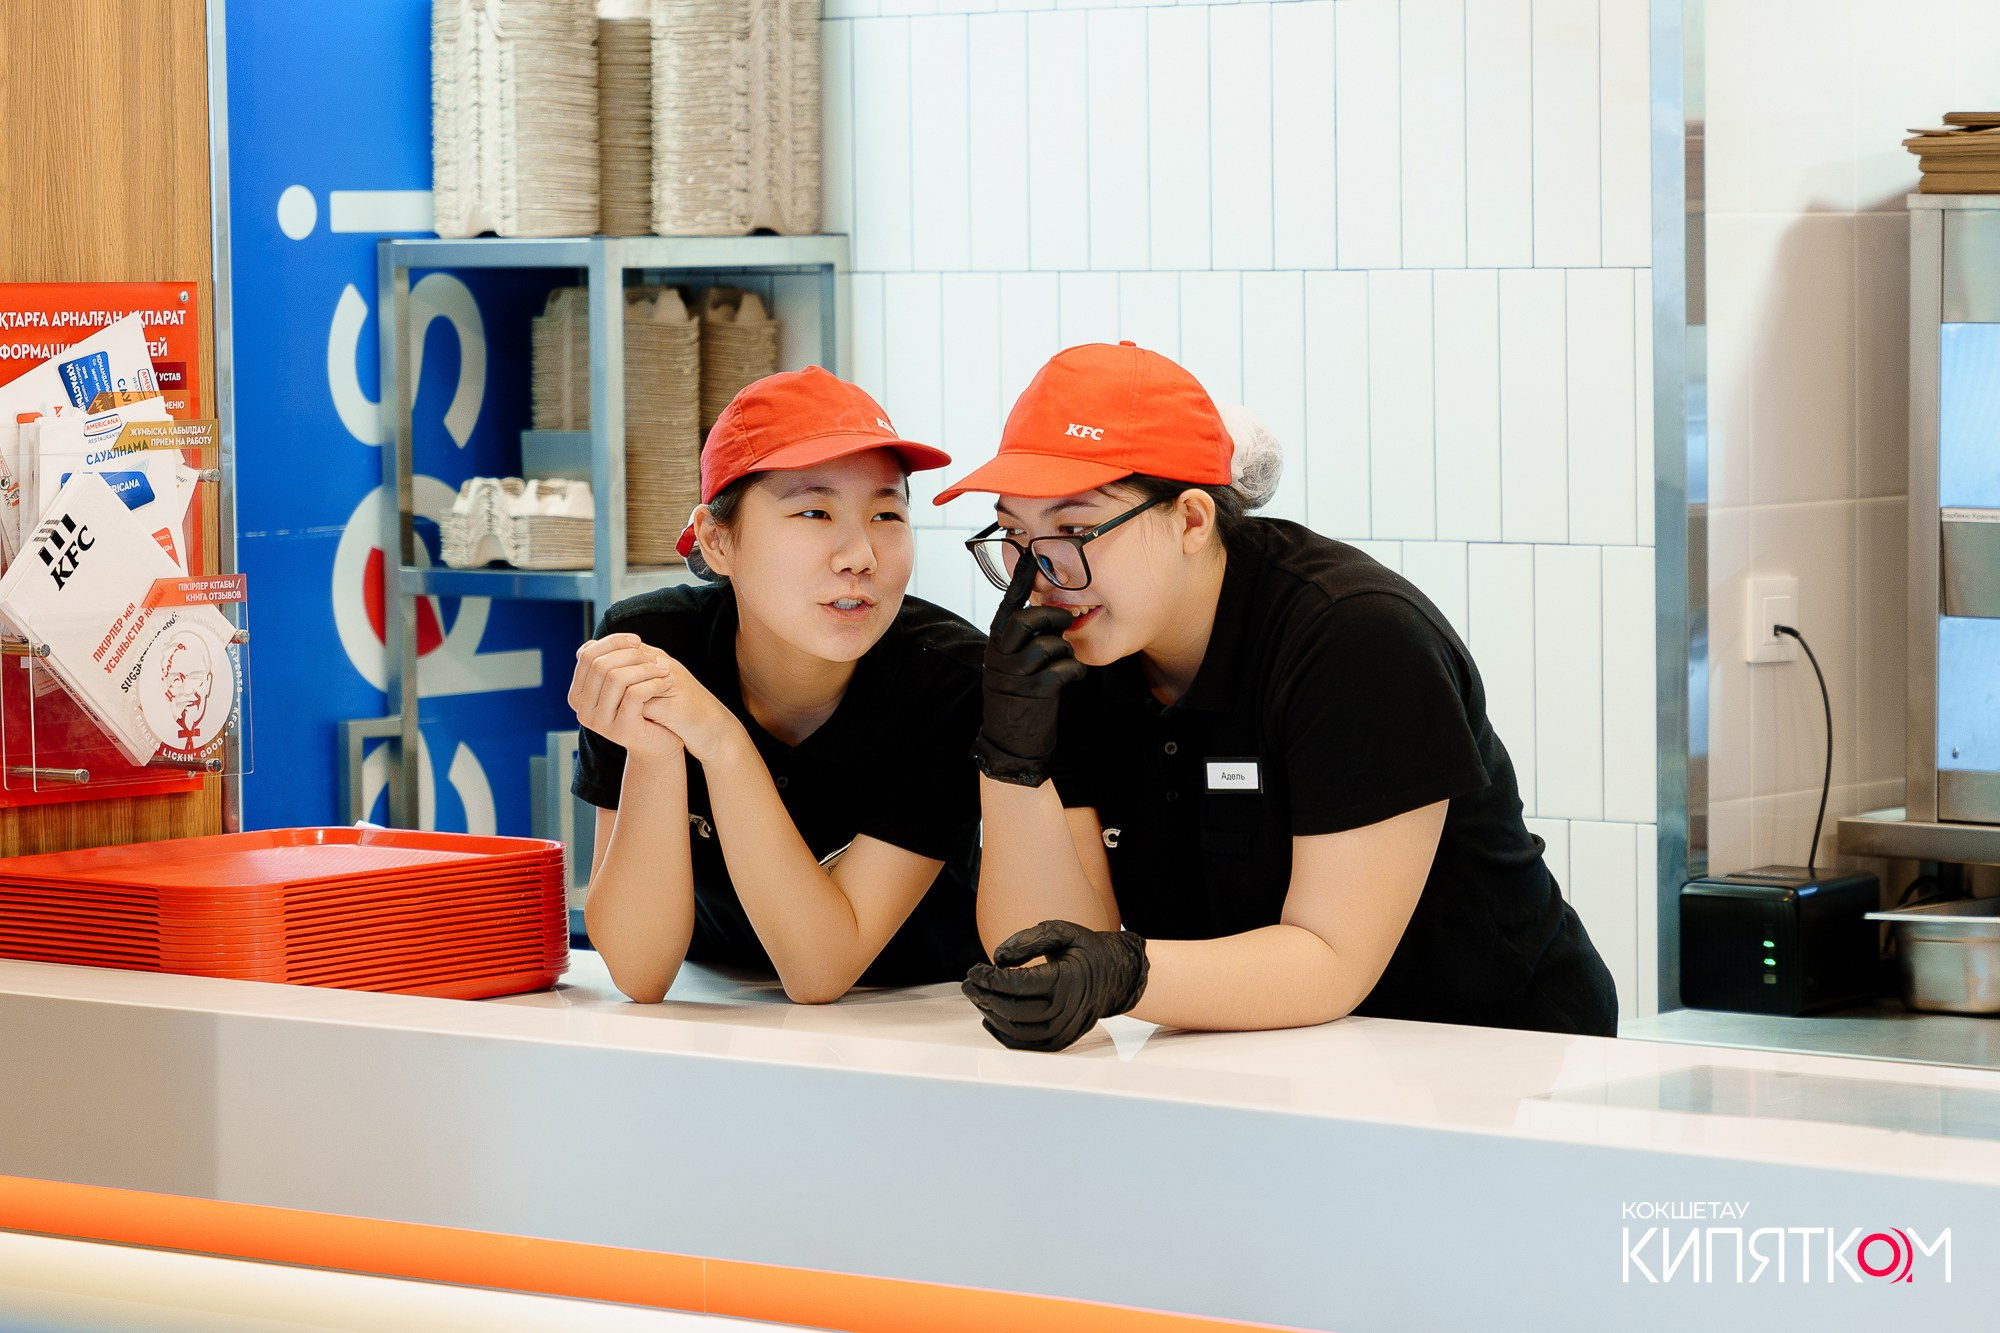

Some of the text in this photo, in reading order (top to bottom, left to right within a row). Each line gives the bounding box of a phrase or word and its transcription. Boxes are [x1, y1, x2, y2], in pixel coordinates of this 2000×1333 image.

[129, 310, 187, 329] ҚПАРАТ
[159, 372, 181, 382] УСТАВ
[86, 417, 119, 431] AMERICANA
[1064, 423, 1105, 441] KFC
[150, 436, 212, 447] ПРИЕМ НА РАБОТУ
[86, 439, 149, 465] САУАЛНАМА
[111, 478, 141, 494] RICANA
[50, 525, 95, 591] KFC
[185, 590, 242, 602] КНИГА ОТЗЫВОВ
[92, 602, 136, 663] ПІКІРЛЕР МЕН
[200, 737, 224, 758] GOOD
